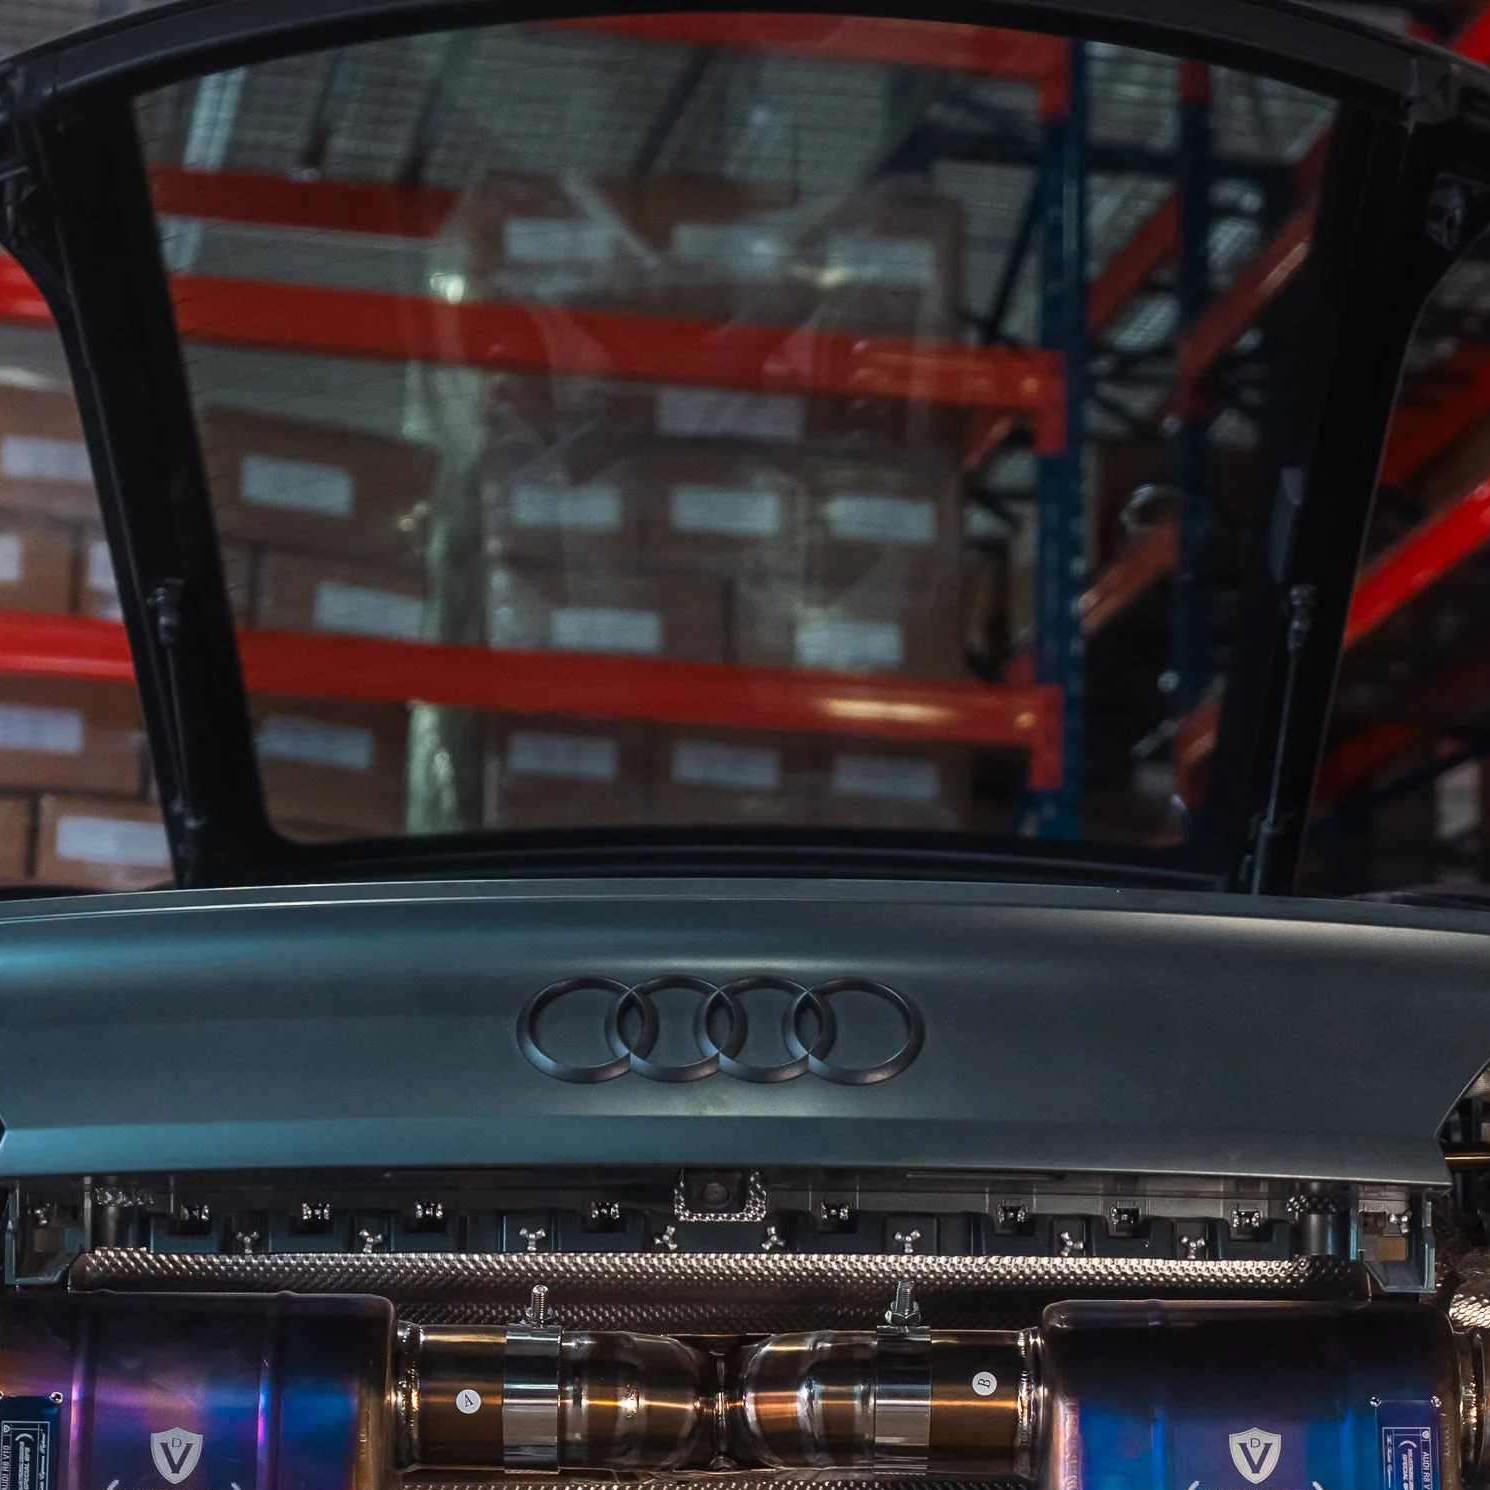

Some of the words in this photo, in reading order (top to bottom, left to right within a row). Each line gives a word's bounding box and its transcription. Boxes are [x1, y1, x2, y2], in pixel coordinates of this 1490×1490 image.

[977, 1379, 991, 1388] B
[464, 1393, 474, 1407] A
[171, 1437, 182, 1448] D
[1250, 1437, 1261, 1448] D
[2, 1445, 10, 1460] V10
[160, 1443, 194, 1474] V
[1237, 1443, 1273, 1474] V
[2, 1461, 10, 1471] R8
[1422, 1451, 1430, 1471] AUDI
[1423, 1471, 1431, 1482] R8
